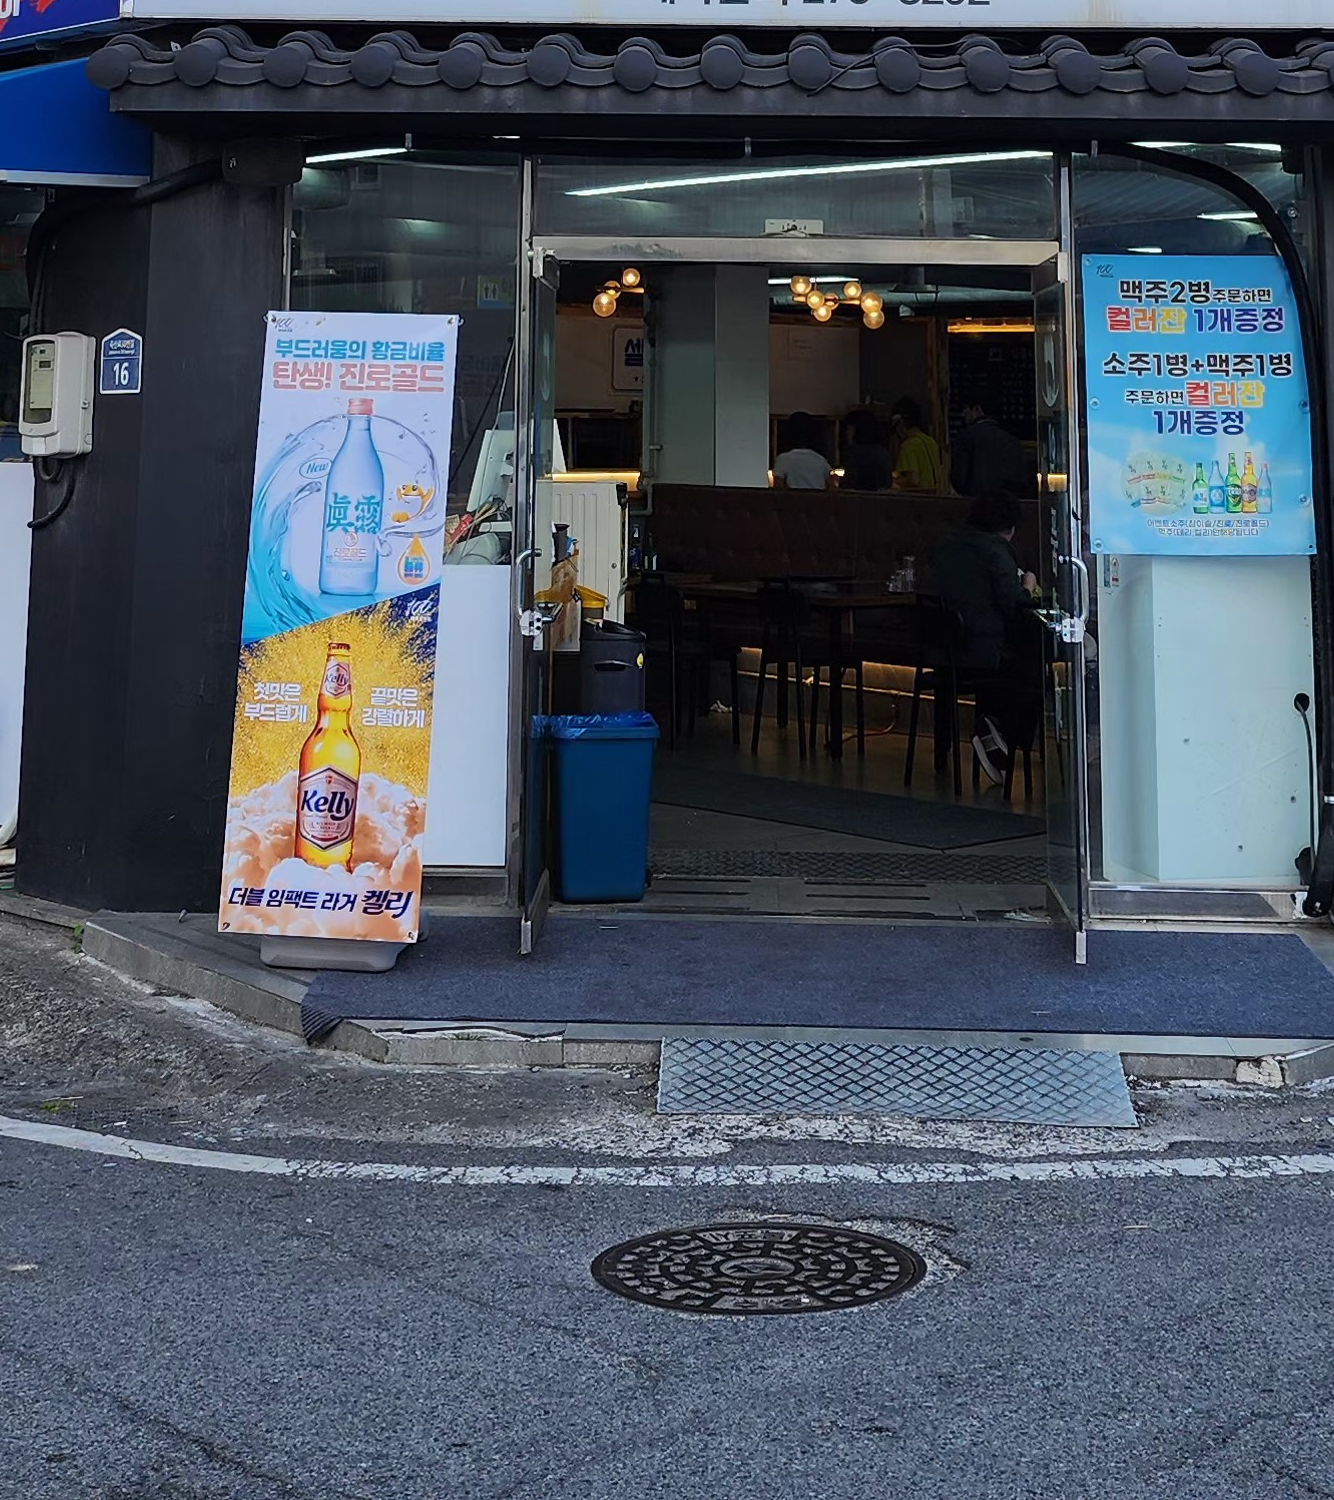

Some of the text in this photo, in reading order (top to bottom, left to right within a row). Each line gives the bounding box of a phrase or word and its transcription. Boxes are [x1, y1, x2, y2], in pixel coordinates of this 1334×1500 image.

[1118, 279, 1272, 304] 맥주2병 주문하면
[1106, 305, 1285, 334] 컬러잔 1개증정
[275, 338, 444, 361] 부드러움의 황금비율
[113, 361, 129, 386] 16
[272, 360, 445, 392] 탄생! 진로골드
[1102, 352, 1293, 378] 소주1병+맥주1병
[1124, 381, 1266, 408] 주문하면 컬러잔
[1152, 410, 1245, 436] 1개증정
[253, 682, 301, 702] 첫맛은
[244, 702, 308, 723] 부드럽게
[362, 707, 425, 728] 강렬하게
[300, 789, 355, 821] Kelly
[228, 887, 414, 919] 더블 임팩트 라거 켈리
